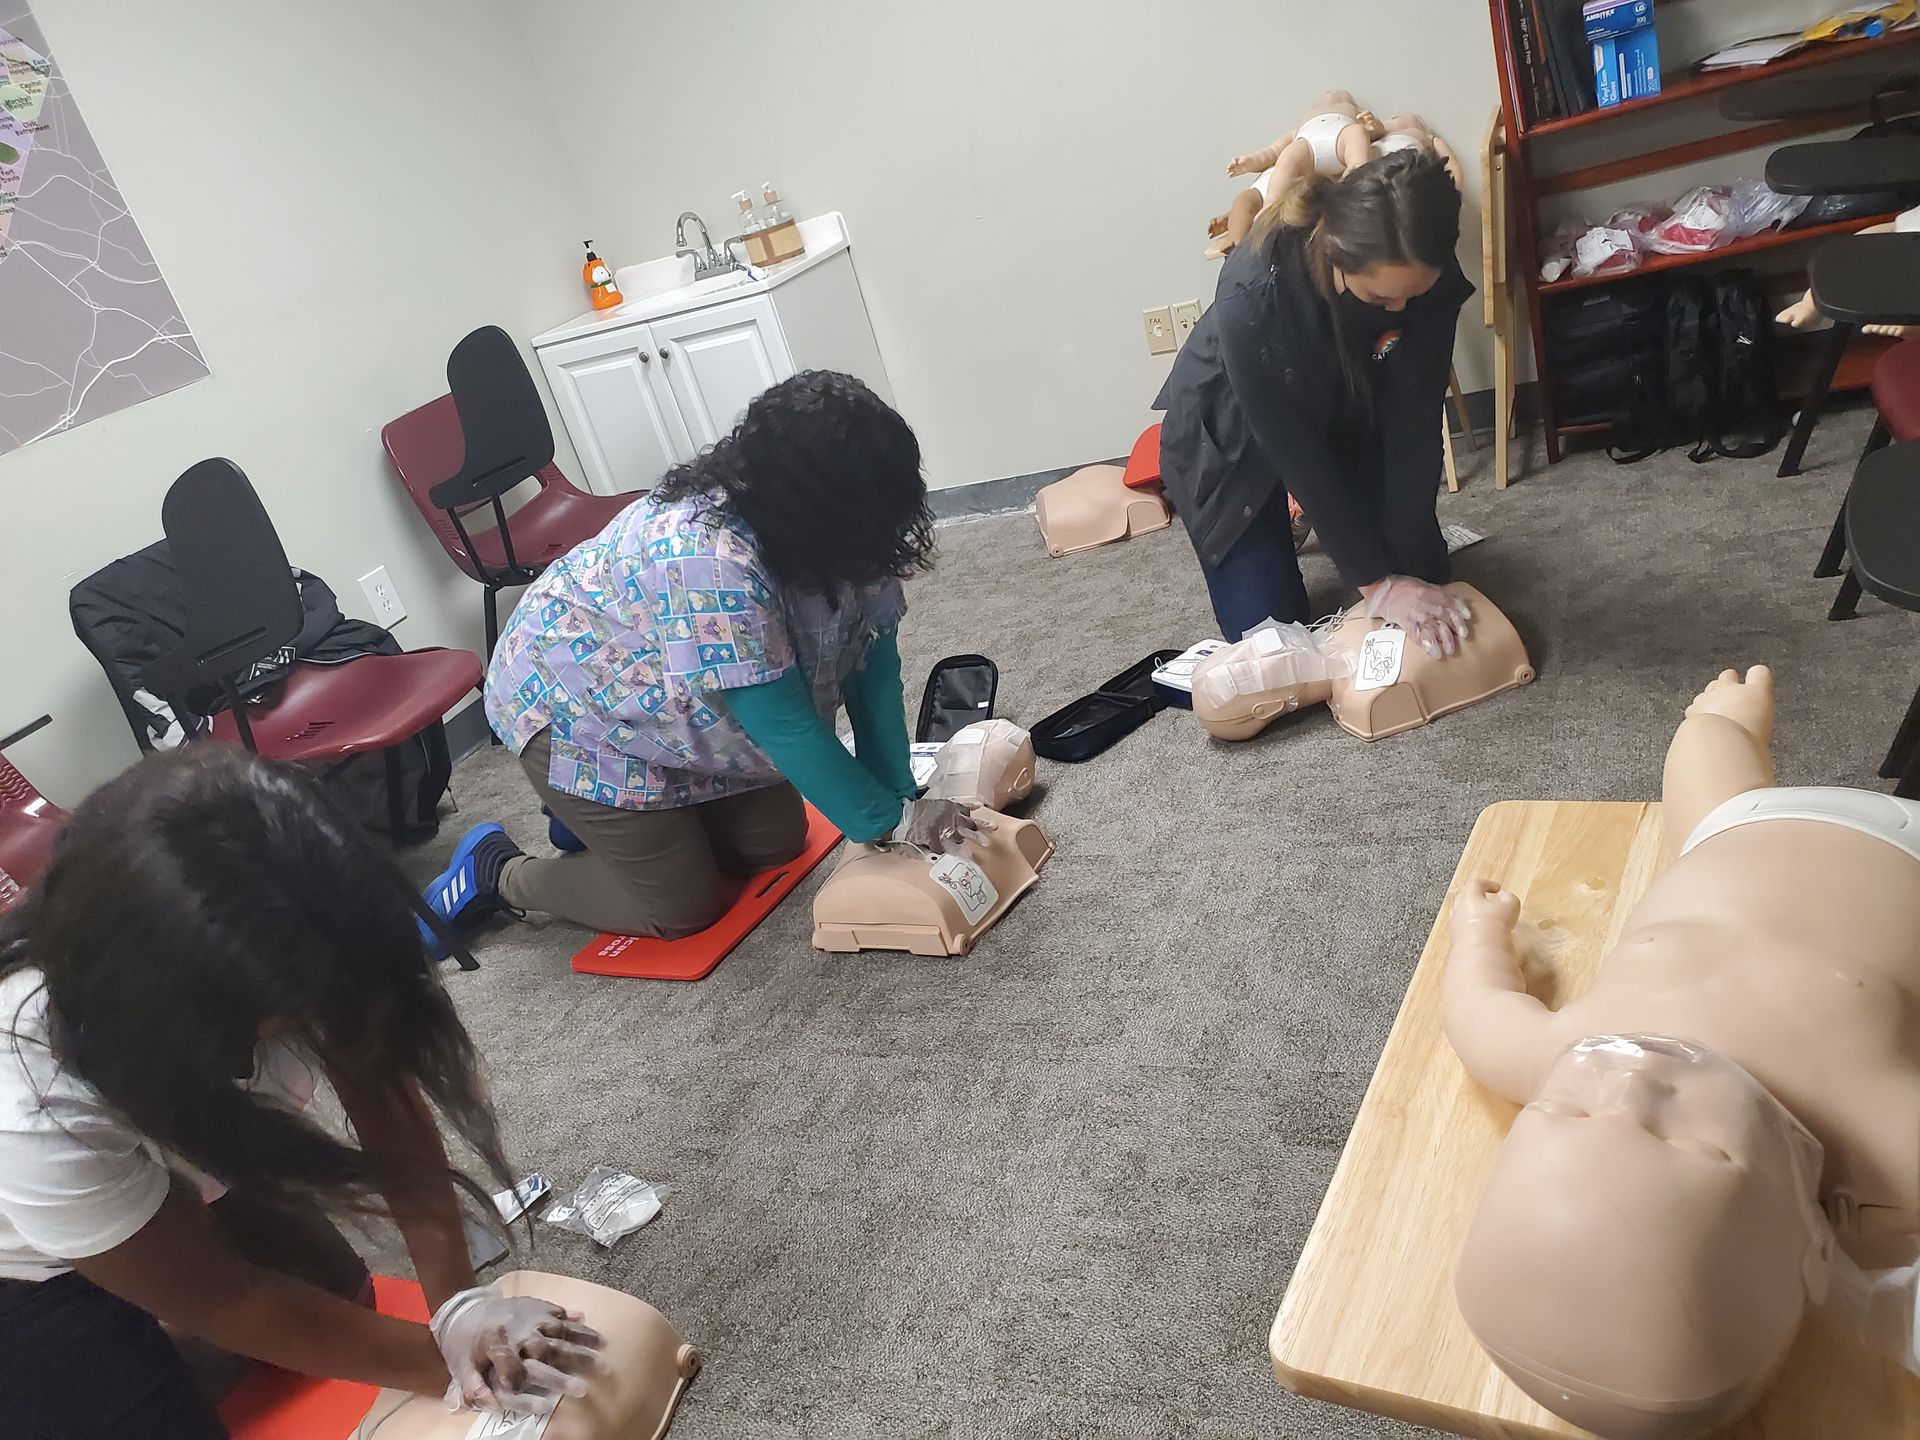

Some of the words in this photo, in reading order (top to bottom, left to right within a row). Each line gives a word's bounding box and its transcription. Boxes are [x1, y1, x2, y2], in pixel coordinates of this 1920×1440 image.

[1635, 4, 1646, 13] LG
[1522, 34, 1530, 52] Exam
[32, 58, 47, 66] East
[20, 80, 42, 90] Capitol
